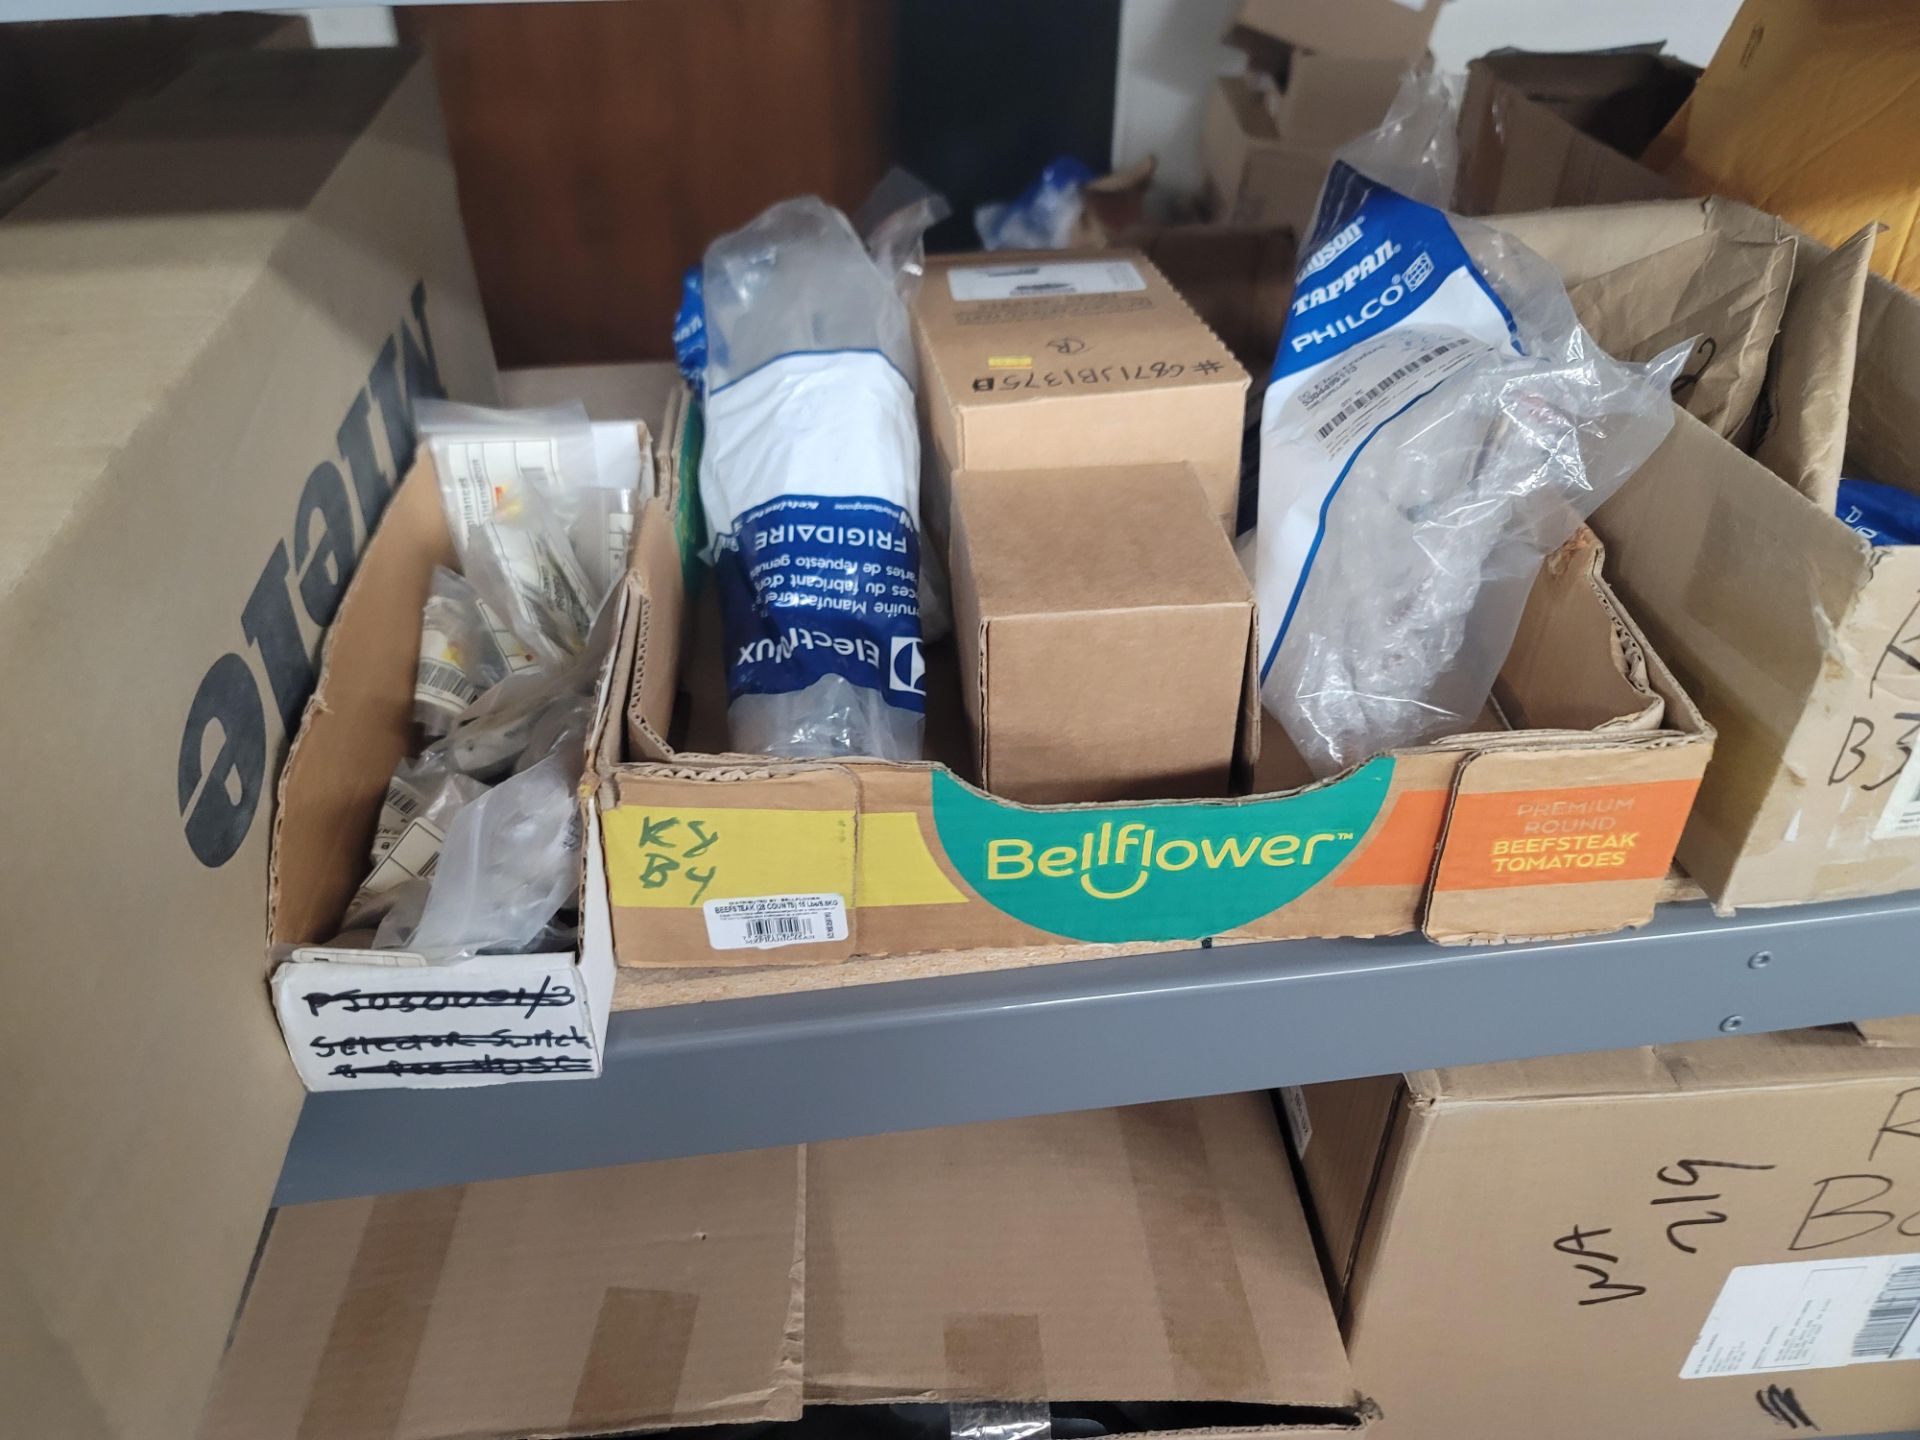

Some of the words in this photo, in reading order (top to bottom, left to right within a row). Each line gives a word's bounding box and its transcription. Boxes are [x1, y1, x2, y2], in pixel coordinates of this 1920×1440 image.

[1291, 283, 1405, 353] PHILCO
[754, 523, 908, 554] FRIGIDAIRE
[795, 556, 858, 577] repuesto
[863, 562, 882, 577] de
[790, 574, 860, 597] fabricant
[865, 582, 887, 597] du
[1517, 796, 1636, 818] PREMIUM
[1524, 816, 1617, 835] ROUND
[987, 822, 1335, 883] Bellflower
[1492, 832, 1639, 856] BEEFSTEAK
[1491, 851, 1627, 873] TOMATOES
